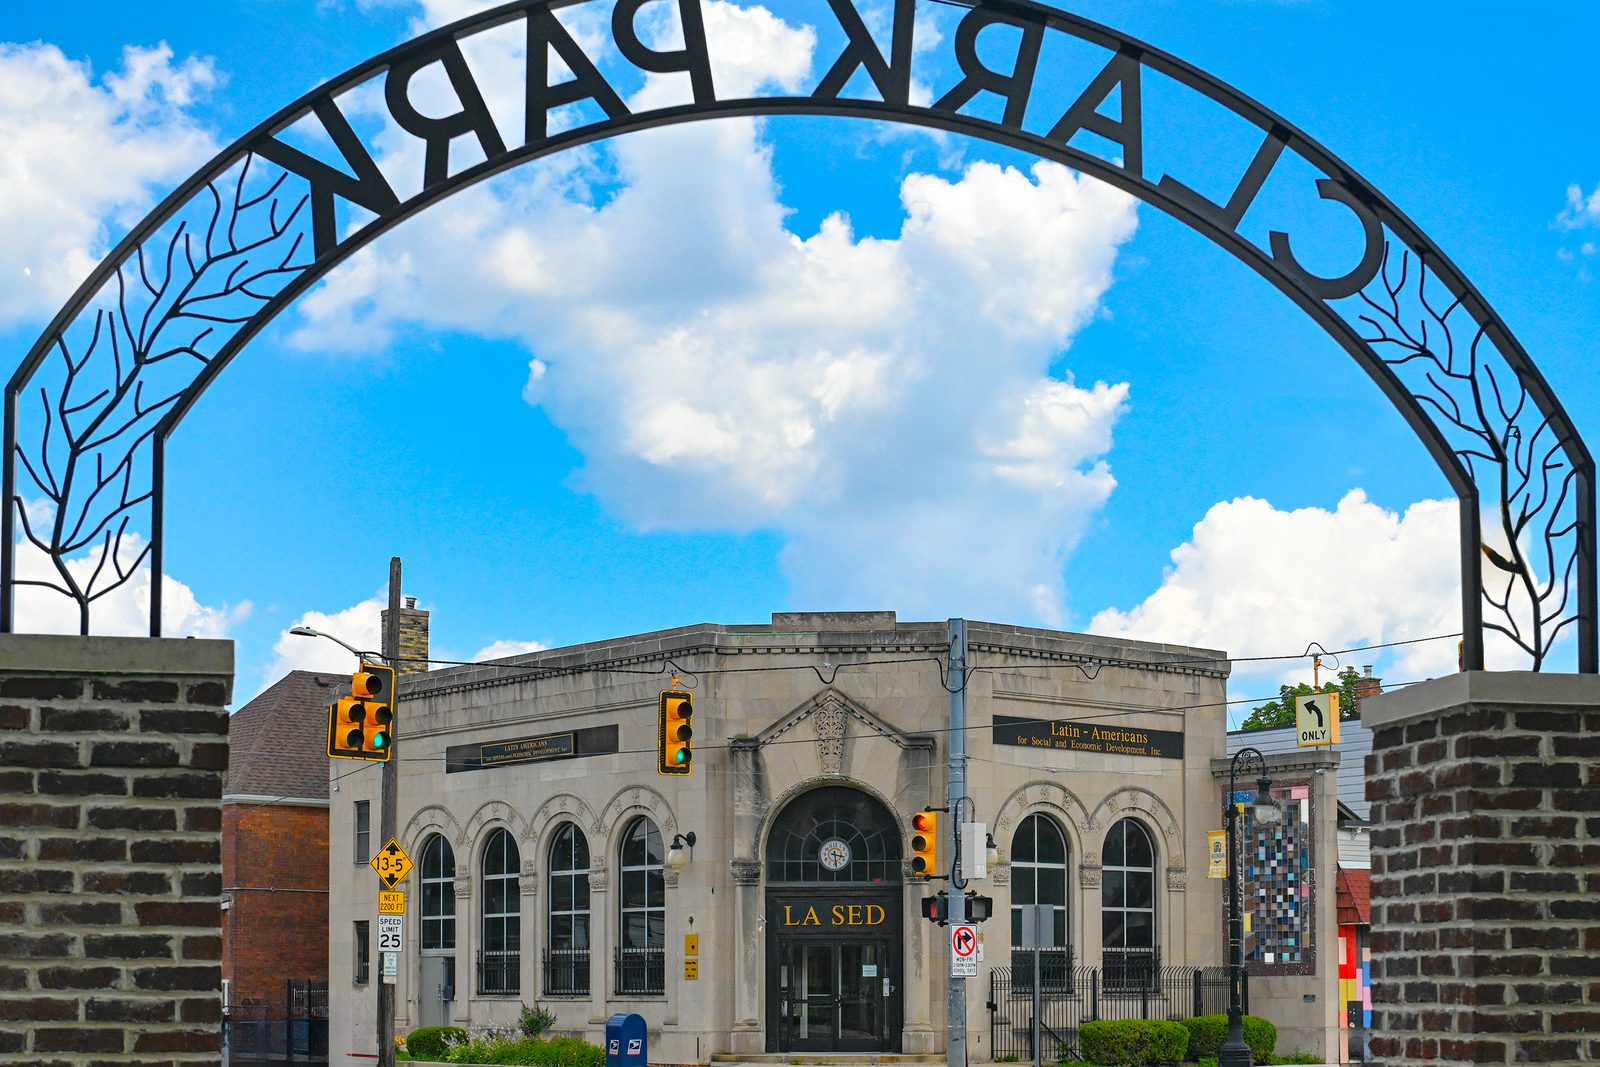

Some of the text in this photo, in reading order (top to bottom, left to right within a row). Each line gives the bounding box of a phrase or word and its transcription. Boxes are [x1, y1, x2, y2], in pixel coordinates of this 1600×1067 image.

[1051, 721, 1080, 738] Latin
[1091, 726, 1148, 744] Americans
[1302, 730, 1326, 741] ONLY
[504, 740, 548, 752] LATIN AMERICANS
[1017, 735, 1027, 745] for
[1031, 736, 1051, 747] Social
[1055, 739, 1067, 748] and
[1071, 740, 1102, 751] Economic
[1150, 747, 1162, 756] Inc.
[383, 894, 399, 902] NEXT
[380, 902, 403, 911] 2200 FT
[783, 904, 886, 926] LA SED
[380, 934, 401, 948] 25
